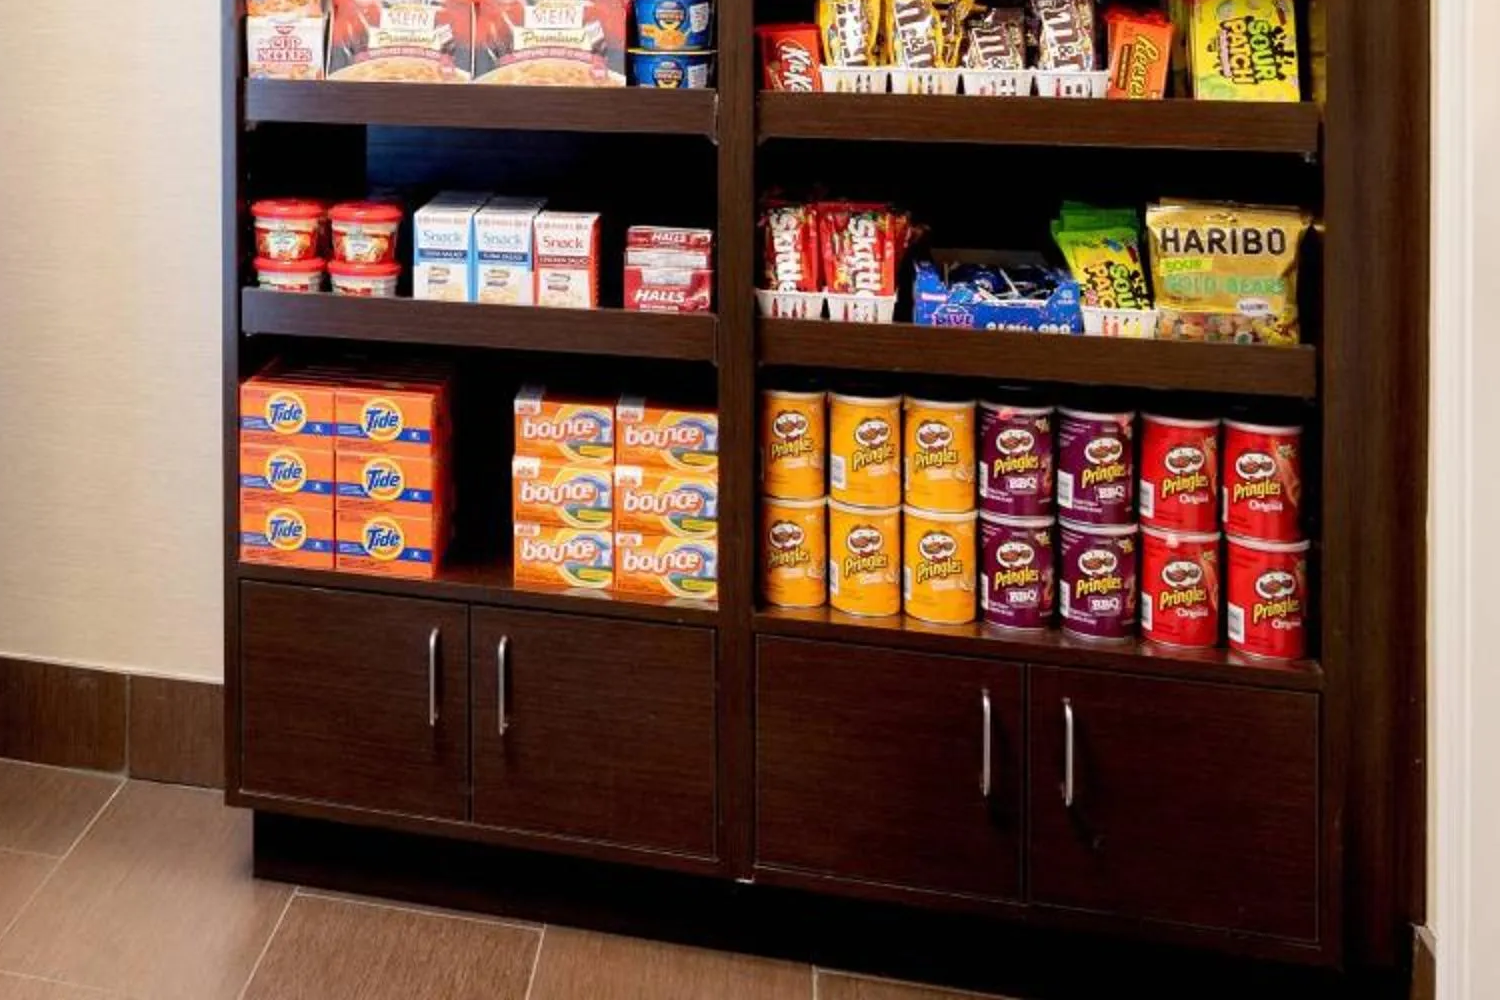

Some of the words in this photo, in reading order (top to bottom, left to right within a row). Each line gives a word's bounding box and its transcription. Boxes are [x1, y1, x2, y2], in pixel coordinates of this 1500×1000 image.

[1224, 19, 1255, 84] PATCH
[1247, 19, 1277, 80] SOUR
[423, 230, 462, 244] Snack
[483, 232, 522, 246] Snack
[543, 236, 584, 250] Snack
[651, 231, 686, 243] HALLS
[1161, 226, 1287, 256] HARIBO
[634, 289, 686, 303] HALLS
[270, 400, 303, 424] Tide
[366, 408, 399, 431] Tide
[522, 418, 595, 441] bounce
[625, 425, 700, 447] bounce
[270, 459, 303, 483] Tide
[915, 448, 959, 471] Pringles
[993, 454, 1039, 477] Pringles
[366, 467, 400, 490] Tide
[1082, 464, 1126, 488] Pringles
[1162, 472, 1208, 498] Pringles
[520, 480, 594, 504] bounce
[623, 489, 700, 513] bounce
[1098, 486, 1125, 500] BBQ
[1233, 482, 1281, 503] Pringles
[270, 517, 303, 541] Tide
[367, 526, 400, 550] Tide
[521, 538, 596, 563] bounce
[623, 550, 699, 573] bounce
[844, 555, 888, 577] Pringles
[916, 559, 963, 582] Pringles
[993, 567, 1039, 590] Pringles
[1075, 575, 1122, 598] Pringles
[1090, 597, 1120, 611] BBQ
[1160, 588, 1207, 610] Pringles
[1252, 598, 1299, 623] Pringles
